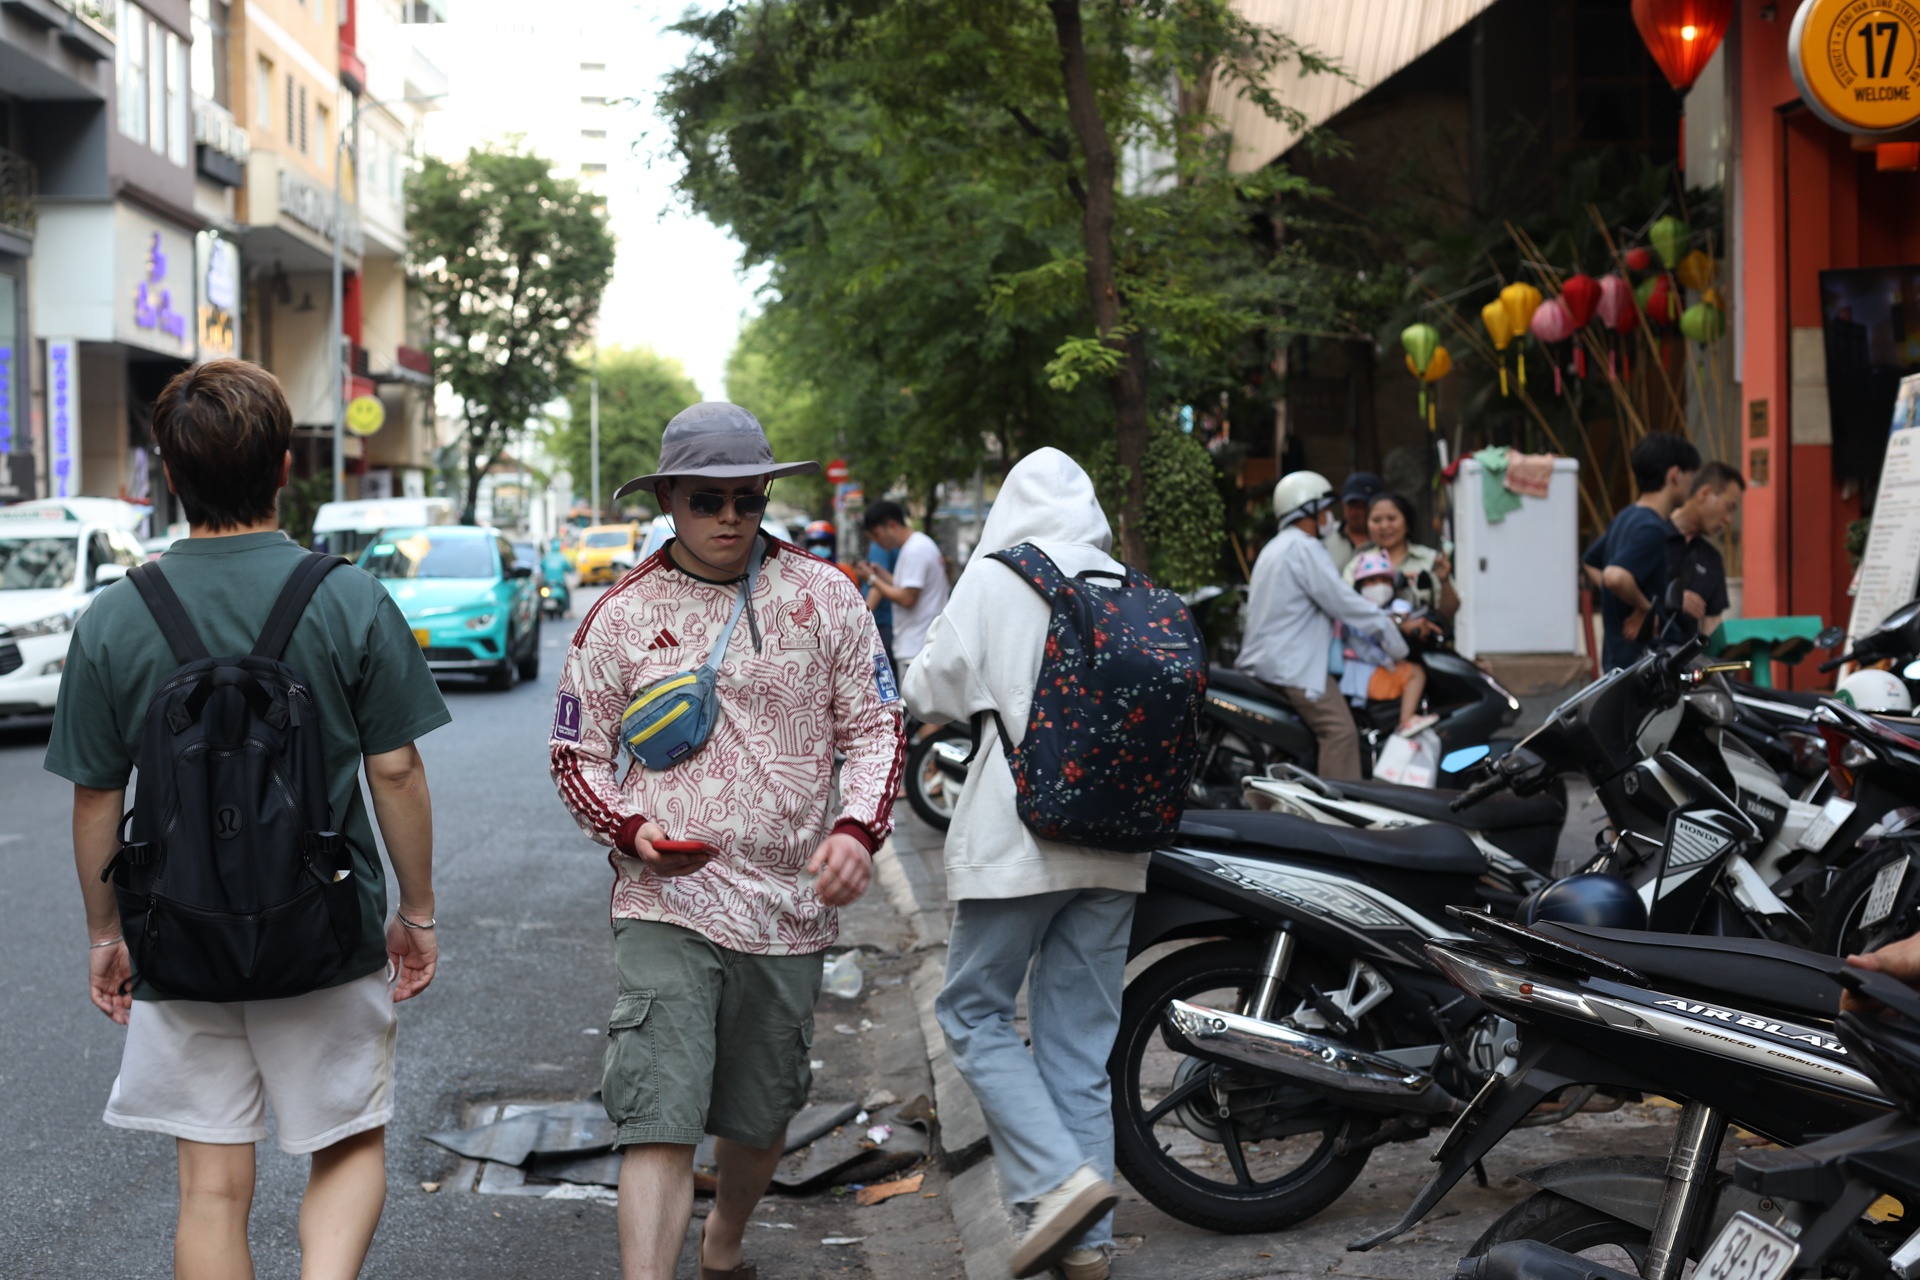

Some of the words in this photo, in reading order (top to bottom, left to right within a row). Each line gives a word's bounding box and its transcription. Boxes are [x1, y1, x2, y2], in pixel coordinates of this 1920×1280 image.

[1895, 2, 1920, 27] STREET
[1858, 22, 1899, 78] 17
[1854, 86, 1911, 102] WELCOME
[1746, 799, 1776, 822] YAMAHA
[1679, 821, 1720, 845] HONDA
[1735, 1015, 1848, 1055] BLAD
[1683, 1026, 1757, 1049] ADVANCED
[1766, 1050, 1844, 1076] COMMUTER
